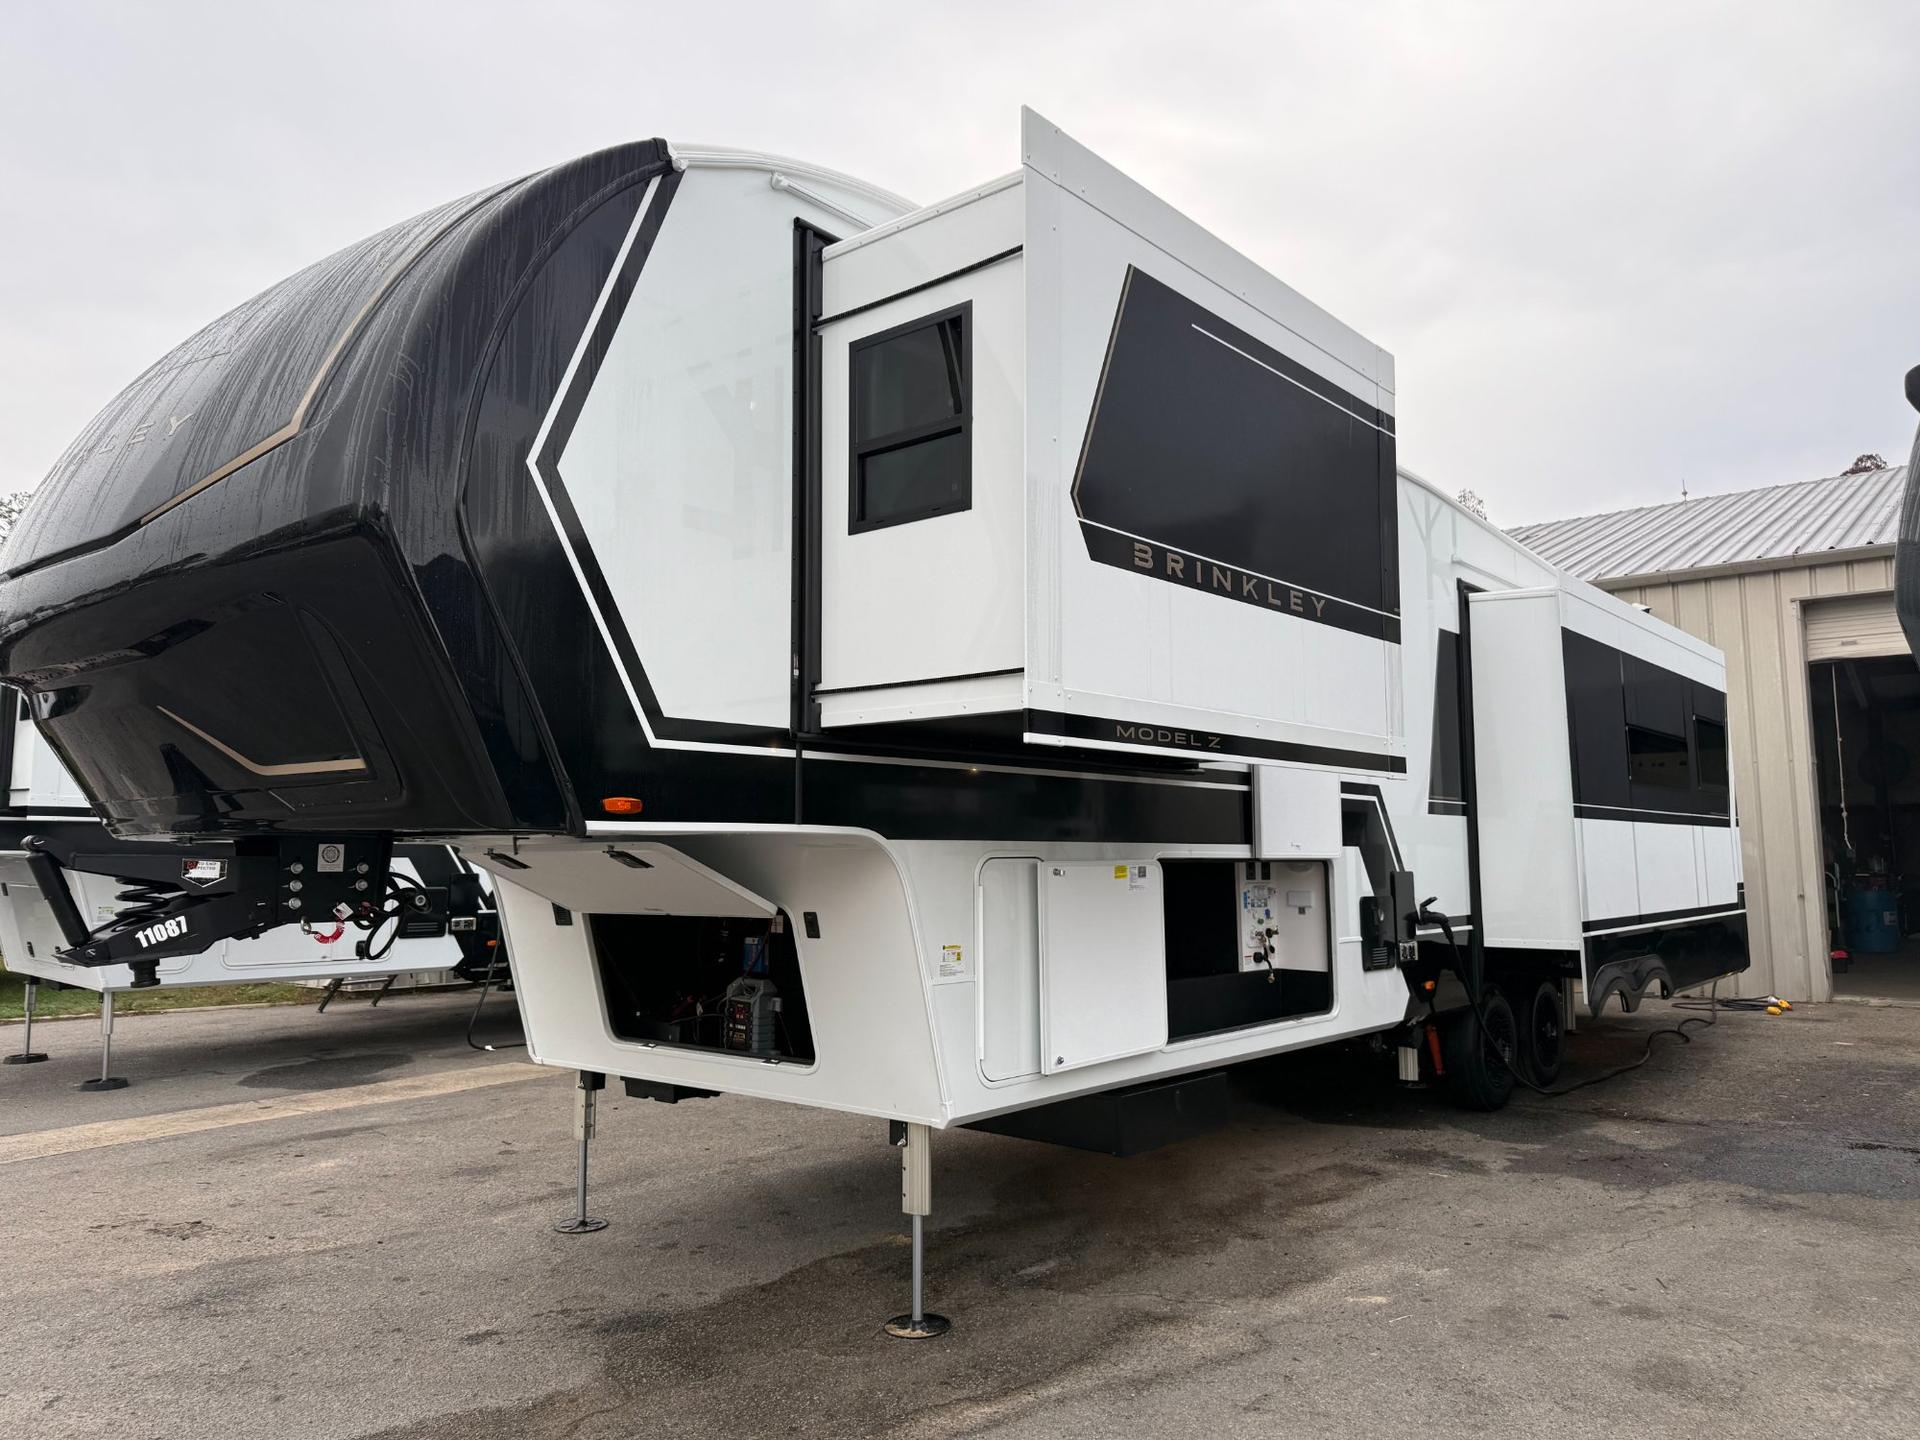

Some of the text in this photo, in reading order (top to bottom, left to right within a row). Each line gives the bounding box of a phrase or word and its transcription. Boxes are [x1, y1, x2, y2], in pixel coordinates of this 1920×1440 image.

[1133, 541, 1327, 617] BRINKLEY
[1115, 725, 1221, 749] MODEL Z
[134, 915, 188, 949] 11087
